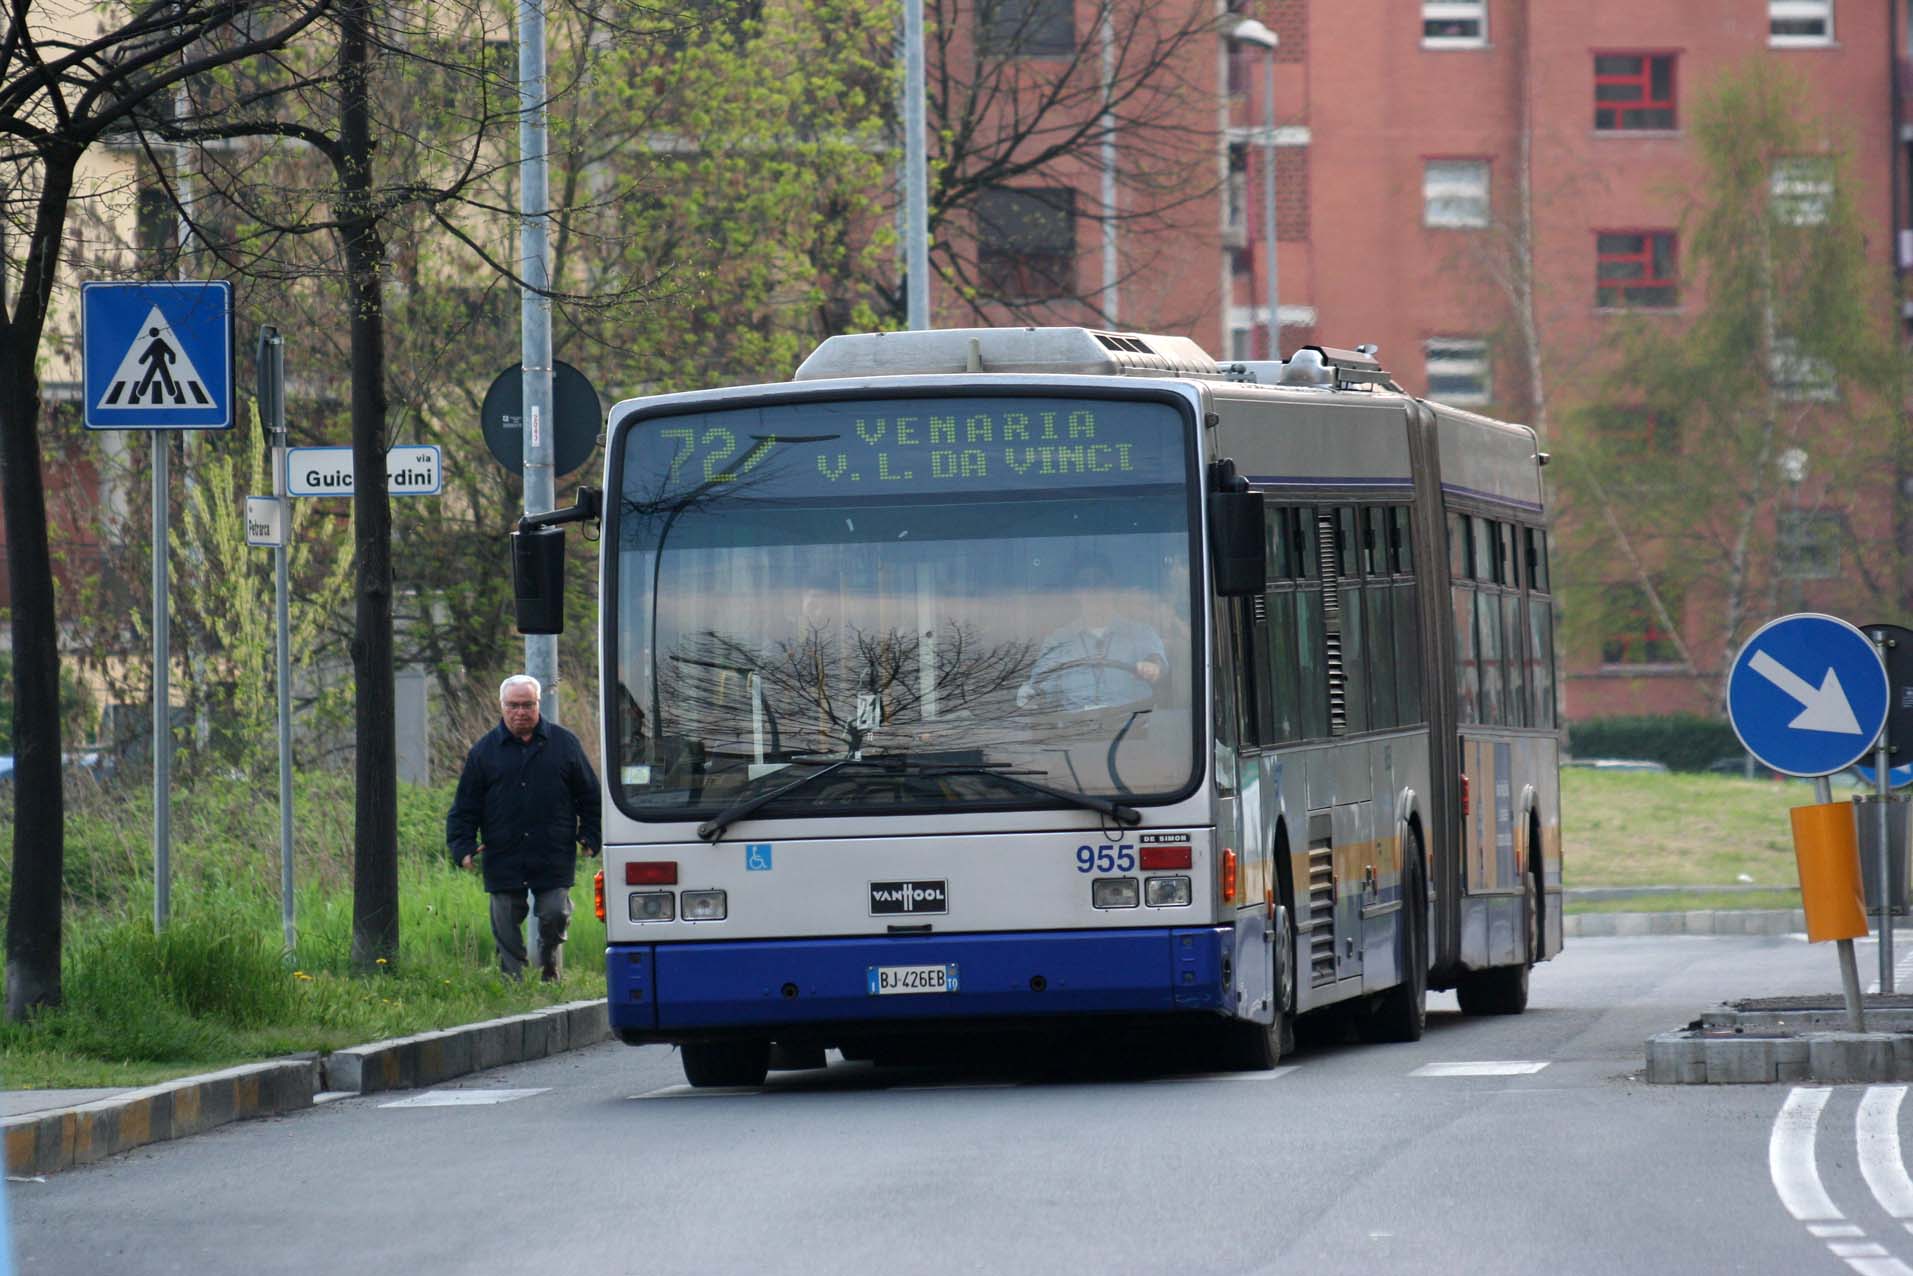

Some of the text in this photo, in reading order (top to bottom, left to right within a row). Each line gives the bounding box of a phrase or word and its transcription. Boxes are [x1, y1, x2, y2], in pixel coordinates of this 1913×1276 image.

[416, 454, 431, 463] via
[931, 449, 987, 478] DA
[1076, 844, 1136, 873] 955
